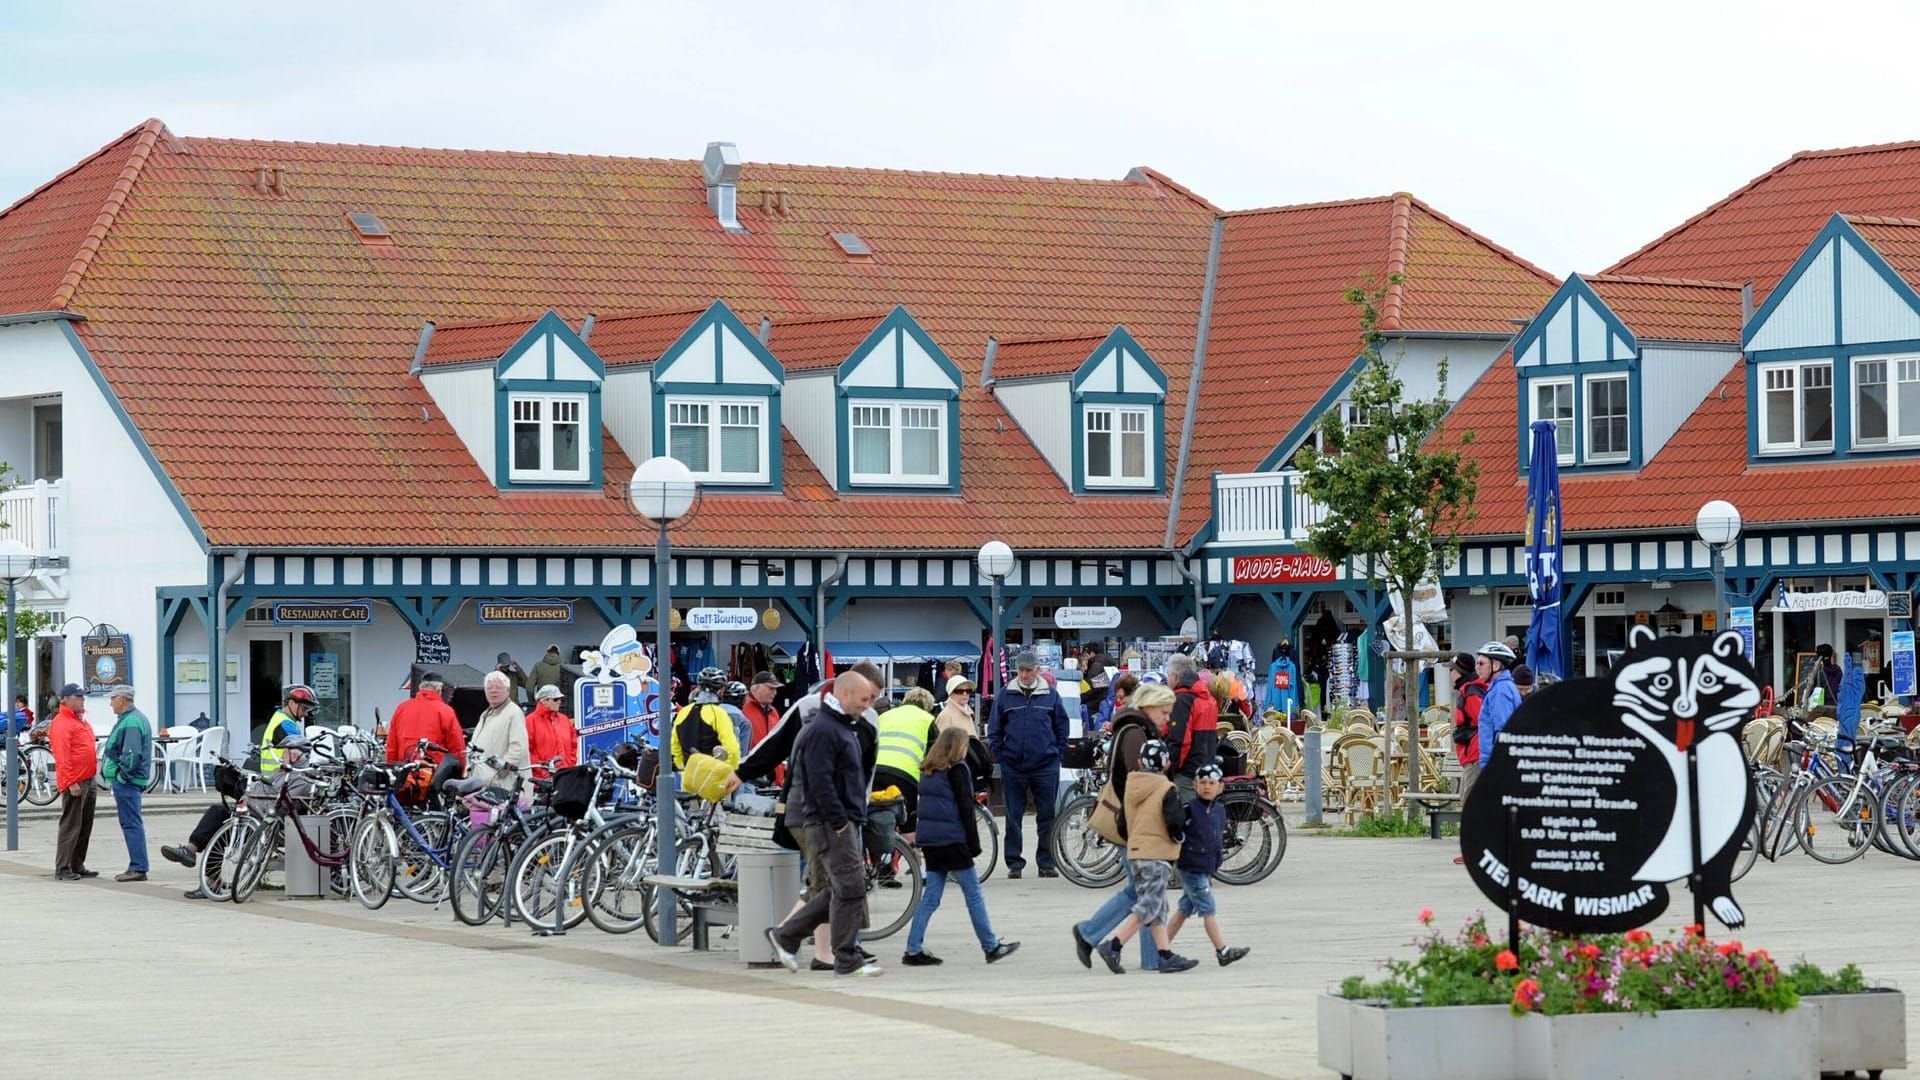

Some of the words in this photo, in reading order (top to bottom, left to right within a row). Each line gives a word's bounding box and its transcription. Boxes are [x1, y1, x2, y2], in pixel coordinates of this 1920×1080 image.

[1236, 556, 1332, 579] MODE-HAUS
[484, 606, 567, 619] Haffterrassen
[1498, 732, 1580, 747] Riesenrutsche,
[1575, 748, 1636, 762] Eisenbahn,
[1517, 759, 1626, 774] Abenteuerspielplatz
[1521, 772, 1540, 783] mit
[1541, 785, 1600, 798] Affeninsel,
[1570, 797, 1592, 808] und
[1541, 816, 1580, 830] täglich
[1582, 817, 1597, 828] ab
[1520, 828, 1546, 840] 9.00
[1547, 829, 1569, 841] Uhr
[1570, 830, 1617, 843] geöffnet
[1536, 849, 1569, 860] Eintritt
[1592, 851, 1601, 860] €
[1597, 862, 1605, 871] €
[1575, 884, 1655, 916] WISMAR
